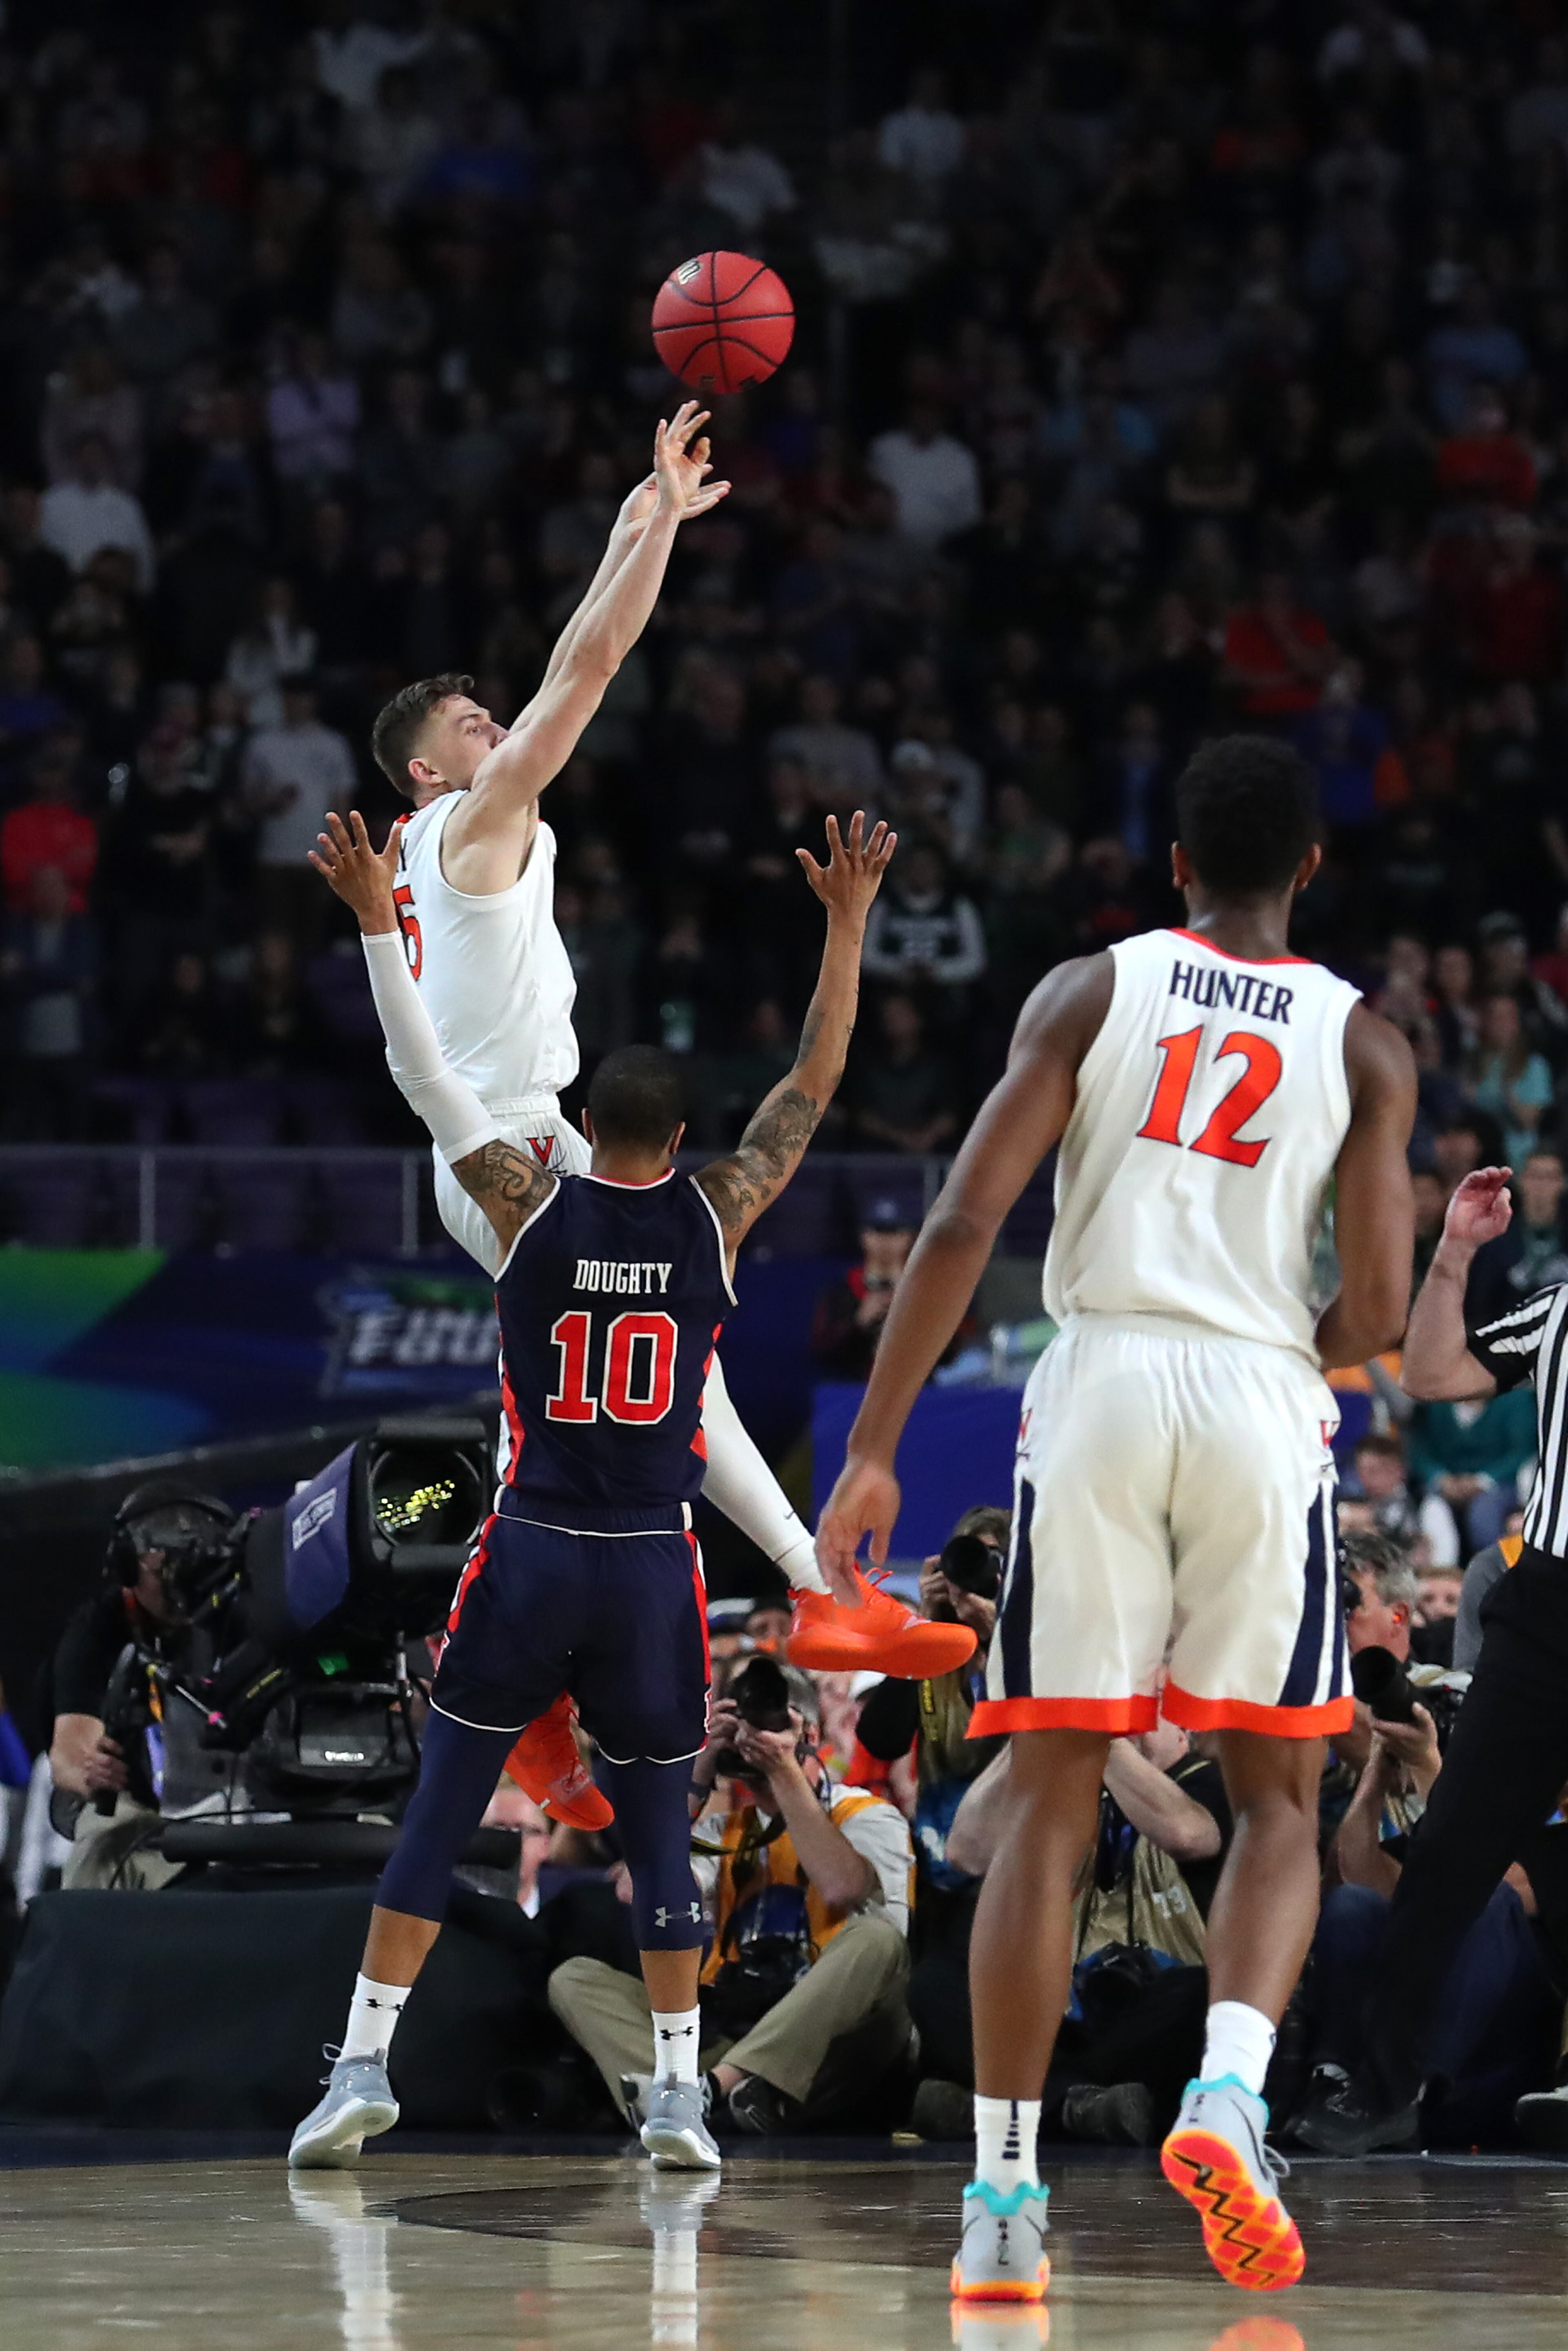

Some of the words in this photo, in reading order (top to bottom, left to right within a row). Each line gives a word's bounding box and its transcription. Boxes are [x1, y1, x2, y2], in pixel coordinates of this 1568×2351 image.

[1169, 959, 1294, 1025] HUNTER
[1136, 1023, 1283, 1168] 12
[572, 1259, 673, 1294] DOUGHTY
[545, 1310, 678, 1425] 10
